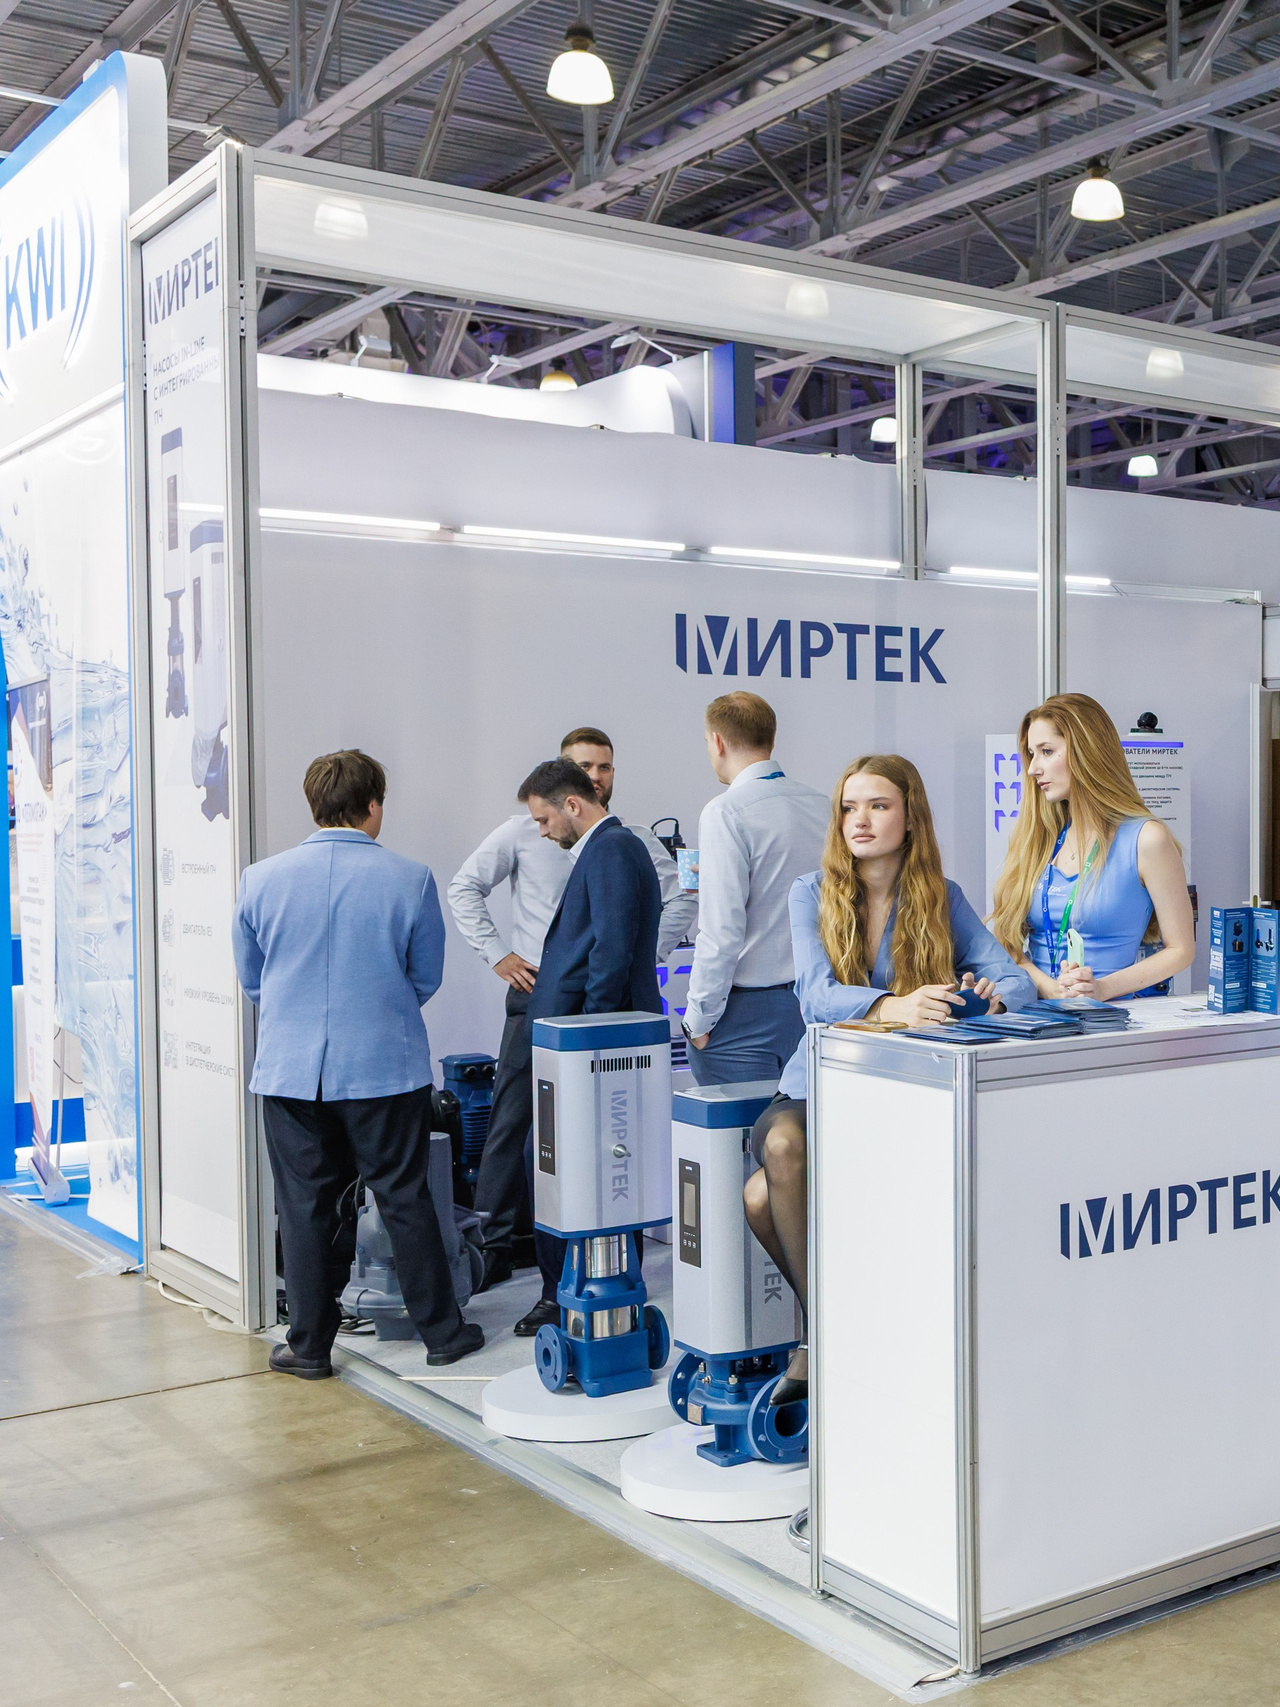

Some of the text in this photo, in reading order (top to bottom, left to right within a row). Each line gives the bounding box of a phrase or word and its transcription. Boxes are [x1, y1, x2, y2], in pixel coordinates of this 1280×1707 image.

[5, 207, 66, 350] KWI
[159, 357, 220, 398] ИНТЕГРИРОВАННЫ
[675, 613, 947, 684] МИРТЕК
